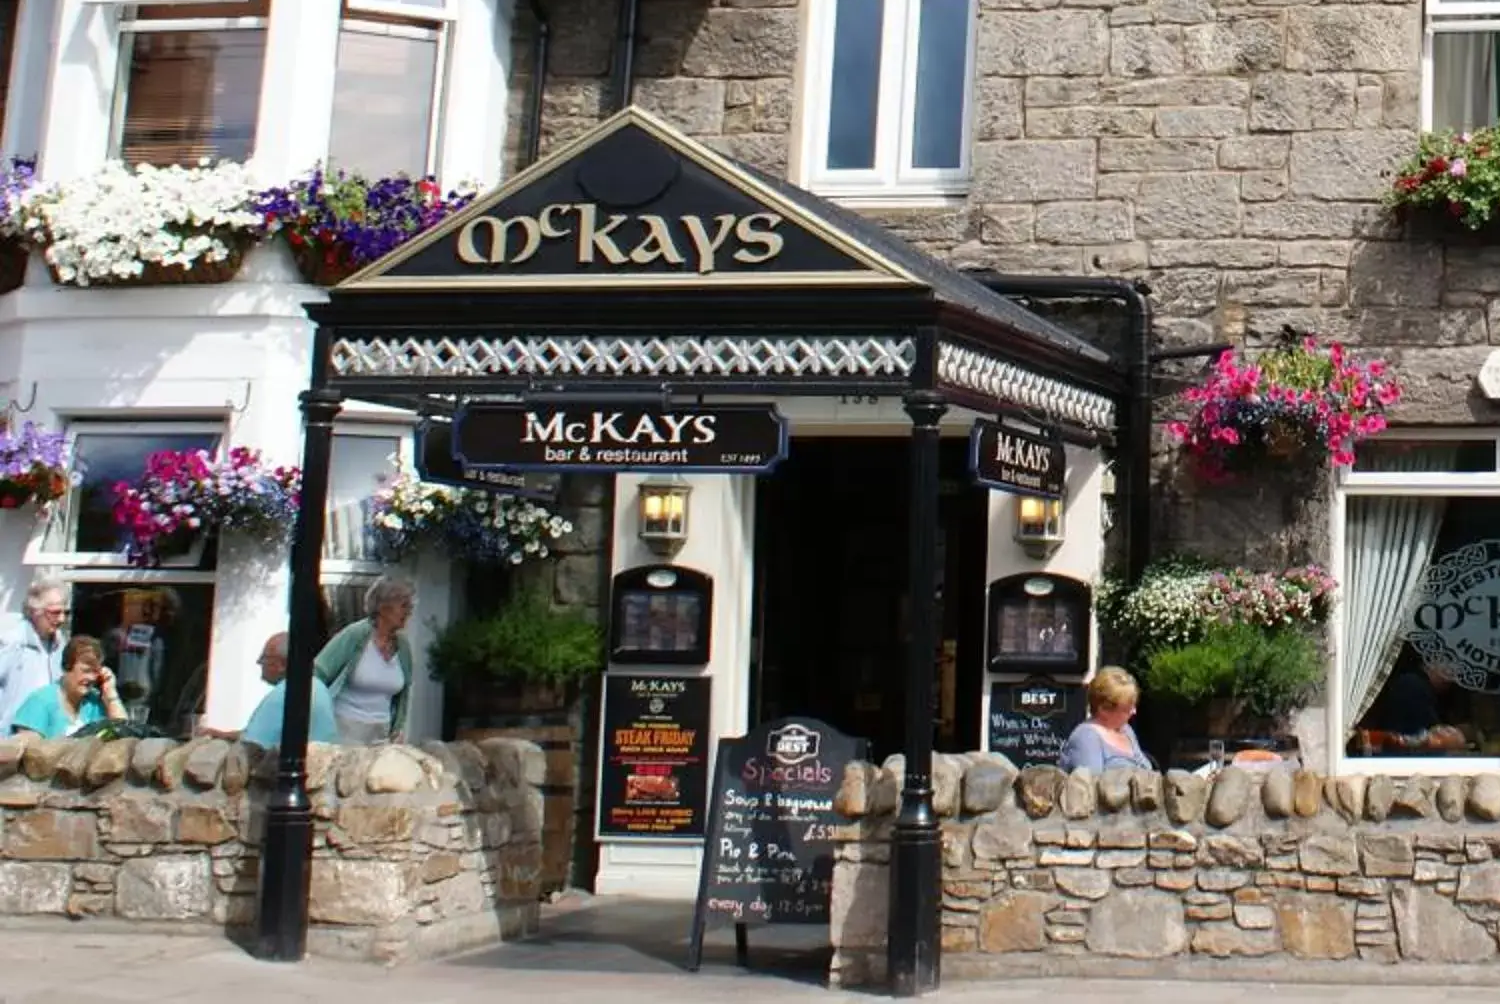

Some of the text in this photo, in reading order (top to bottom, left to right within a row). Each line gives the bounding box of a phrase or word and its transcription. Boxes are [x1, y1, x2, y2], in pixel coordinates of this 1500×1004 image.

[520, 410, 717, 444] McKAYS
[544, 445, 573, 463] bar
[579, 446, 591, 462] &
[995, 431, 1051, 473] McKAYS
[1020, 692, 1057, 705] BEST
[743, 757, 833, 786] Specials
